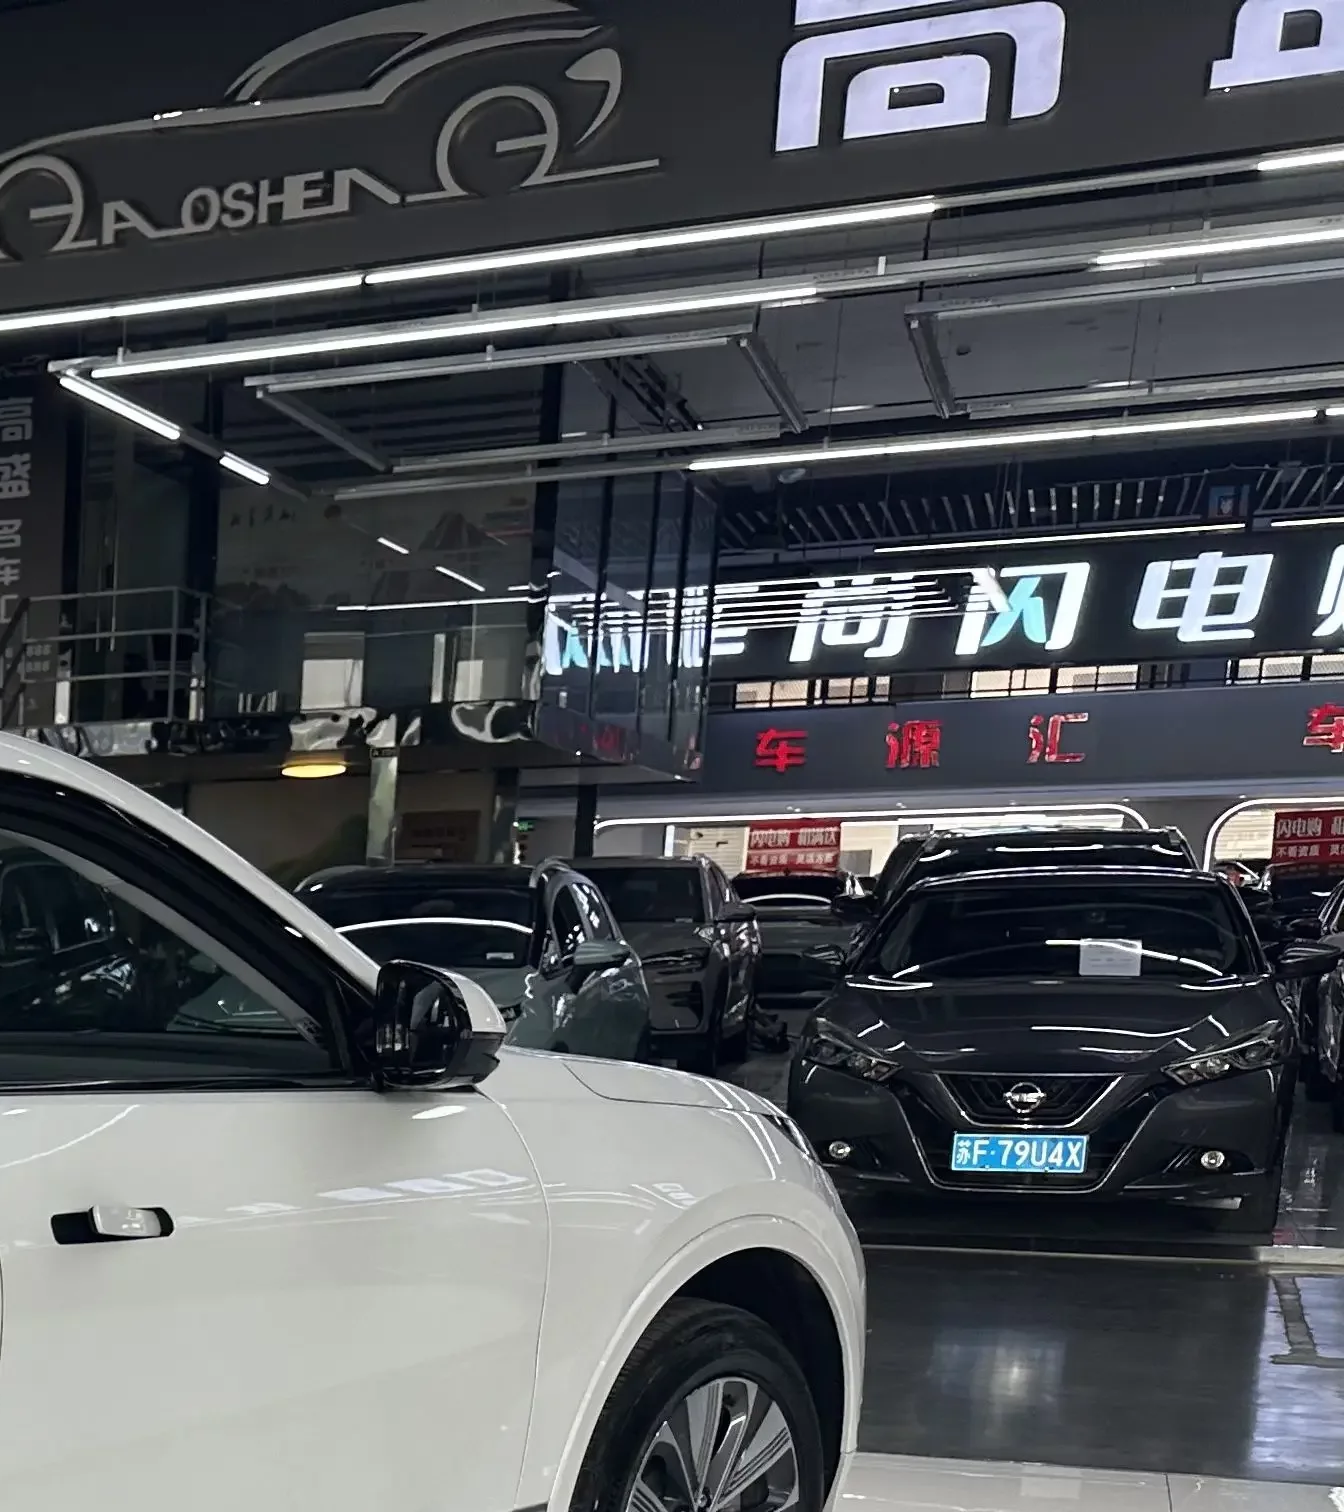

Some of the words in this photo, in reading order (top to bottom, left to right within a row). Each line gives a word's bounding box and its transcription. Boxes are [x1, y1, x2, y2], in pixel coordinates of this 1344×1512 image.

[756, 713, 1090, 774] 车源汇
[1275, 816, 1323, 839] 闪电购
